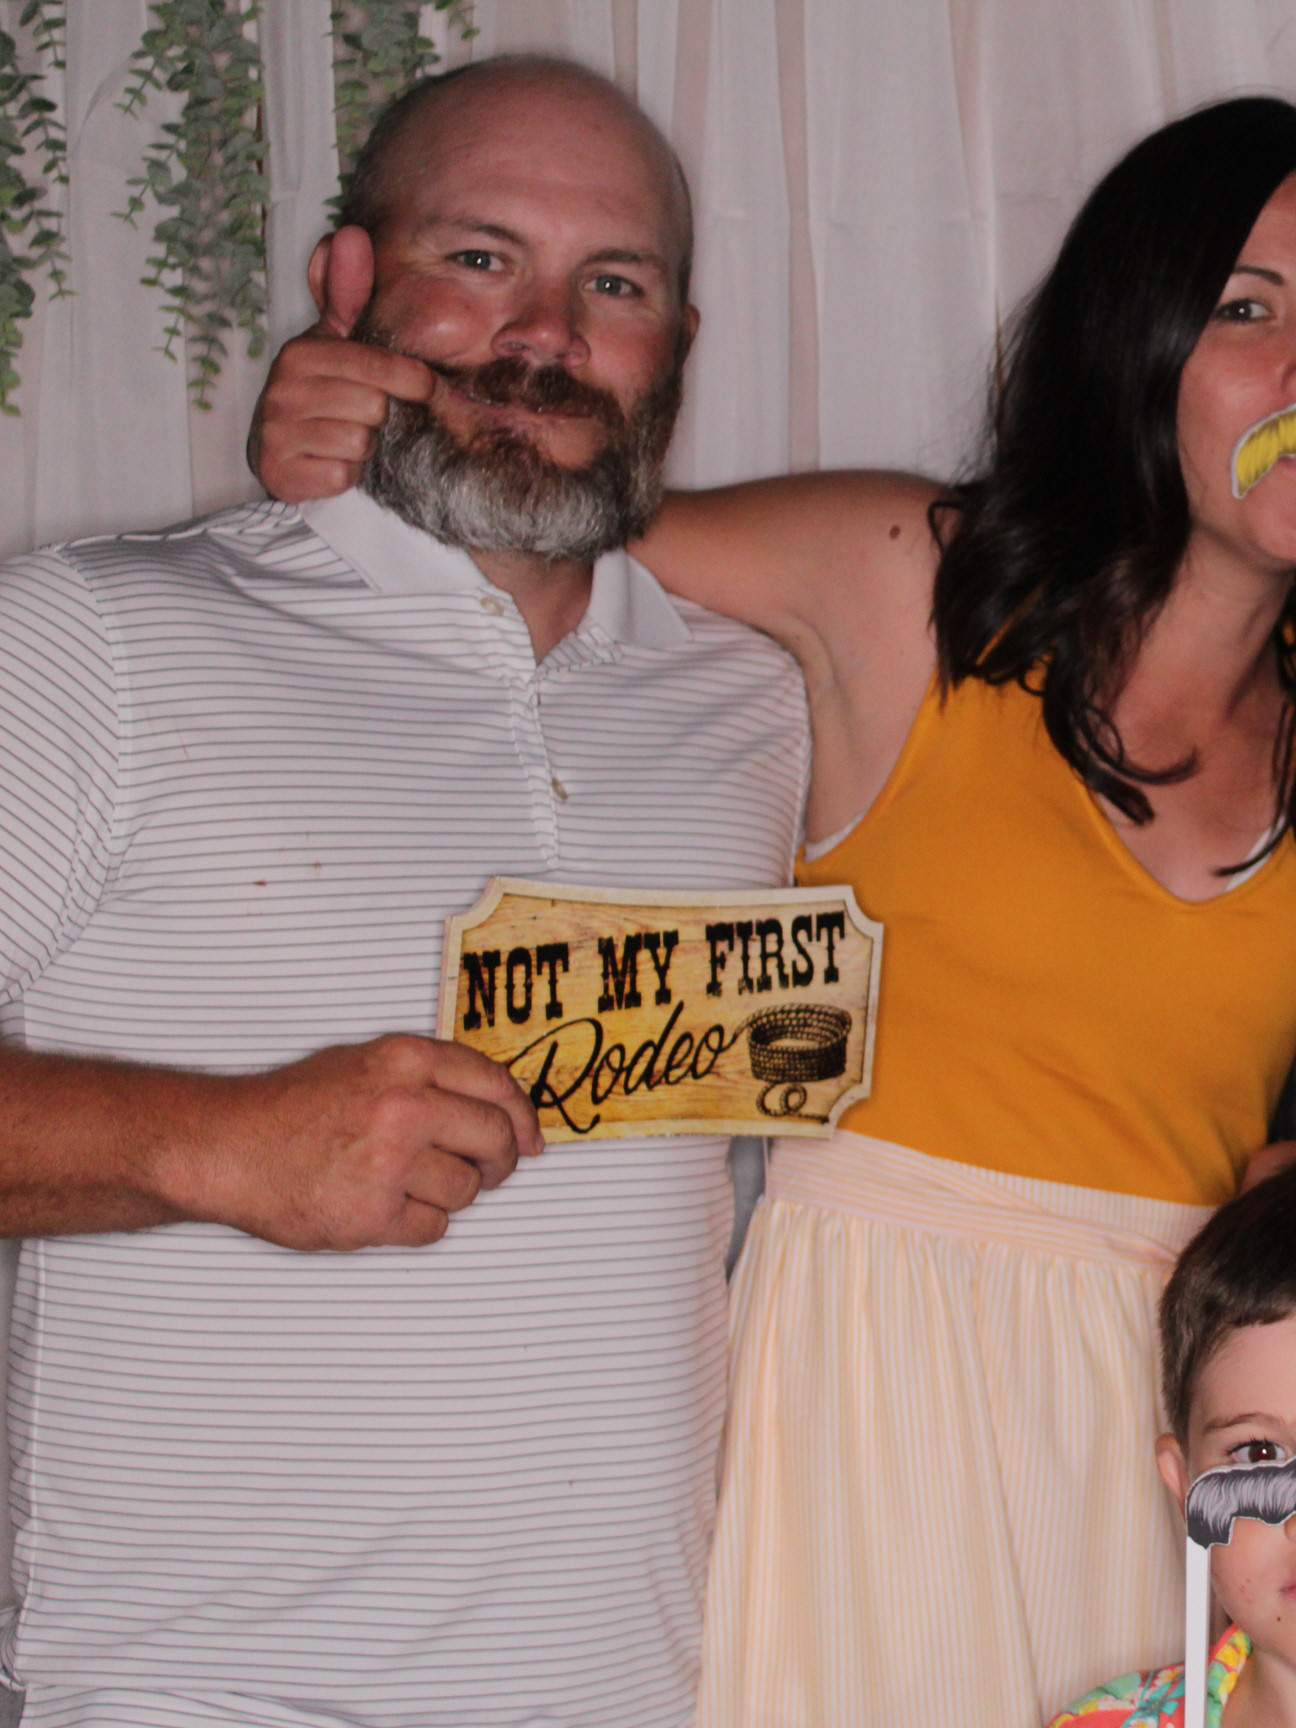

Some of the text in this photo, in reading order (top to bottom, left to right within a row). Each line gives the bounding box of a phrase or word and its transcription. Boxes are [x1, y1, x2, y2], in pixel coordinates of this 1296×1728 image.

[463, 911, 845, 1031] NOT MY FIRST
[506, 1001, 738, 1133] Rodeo
